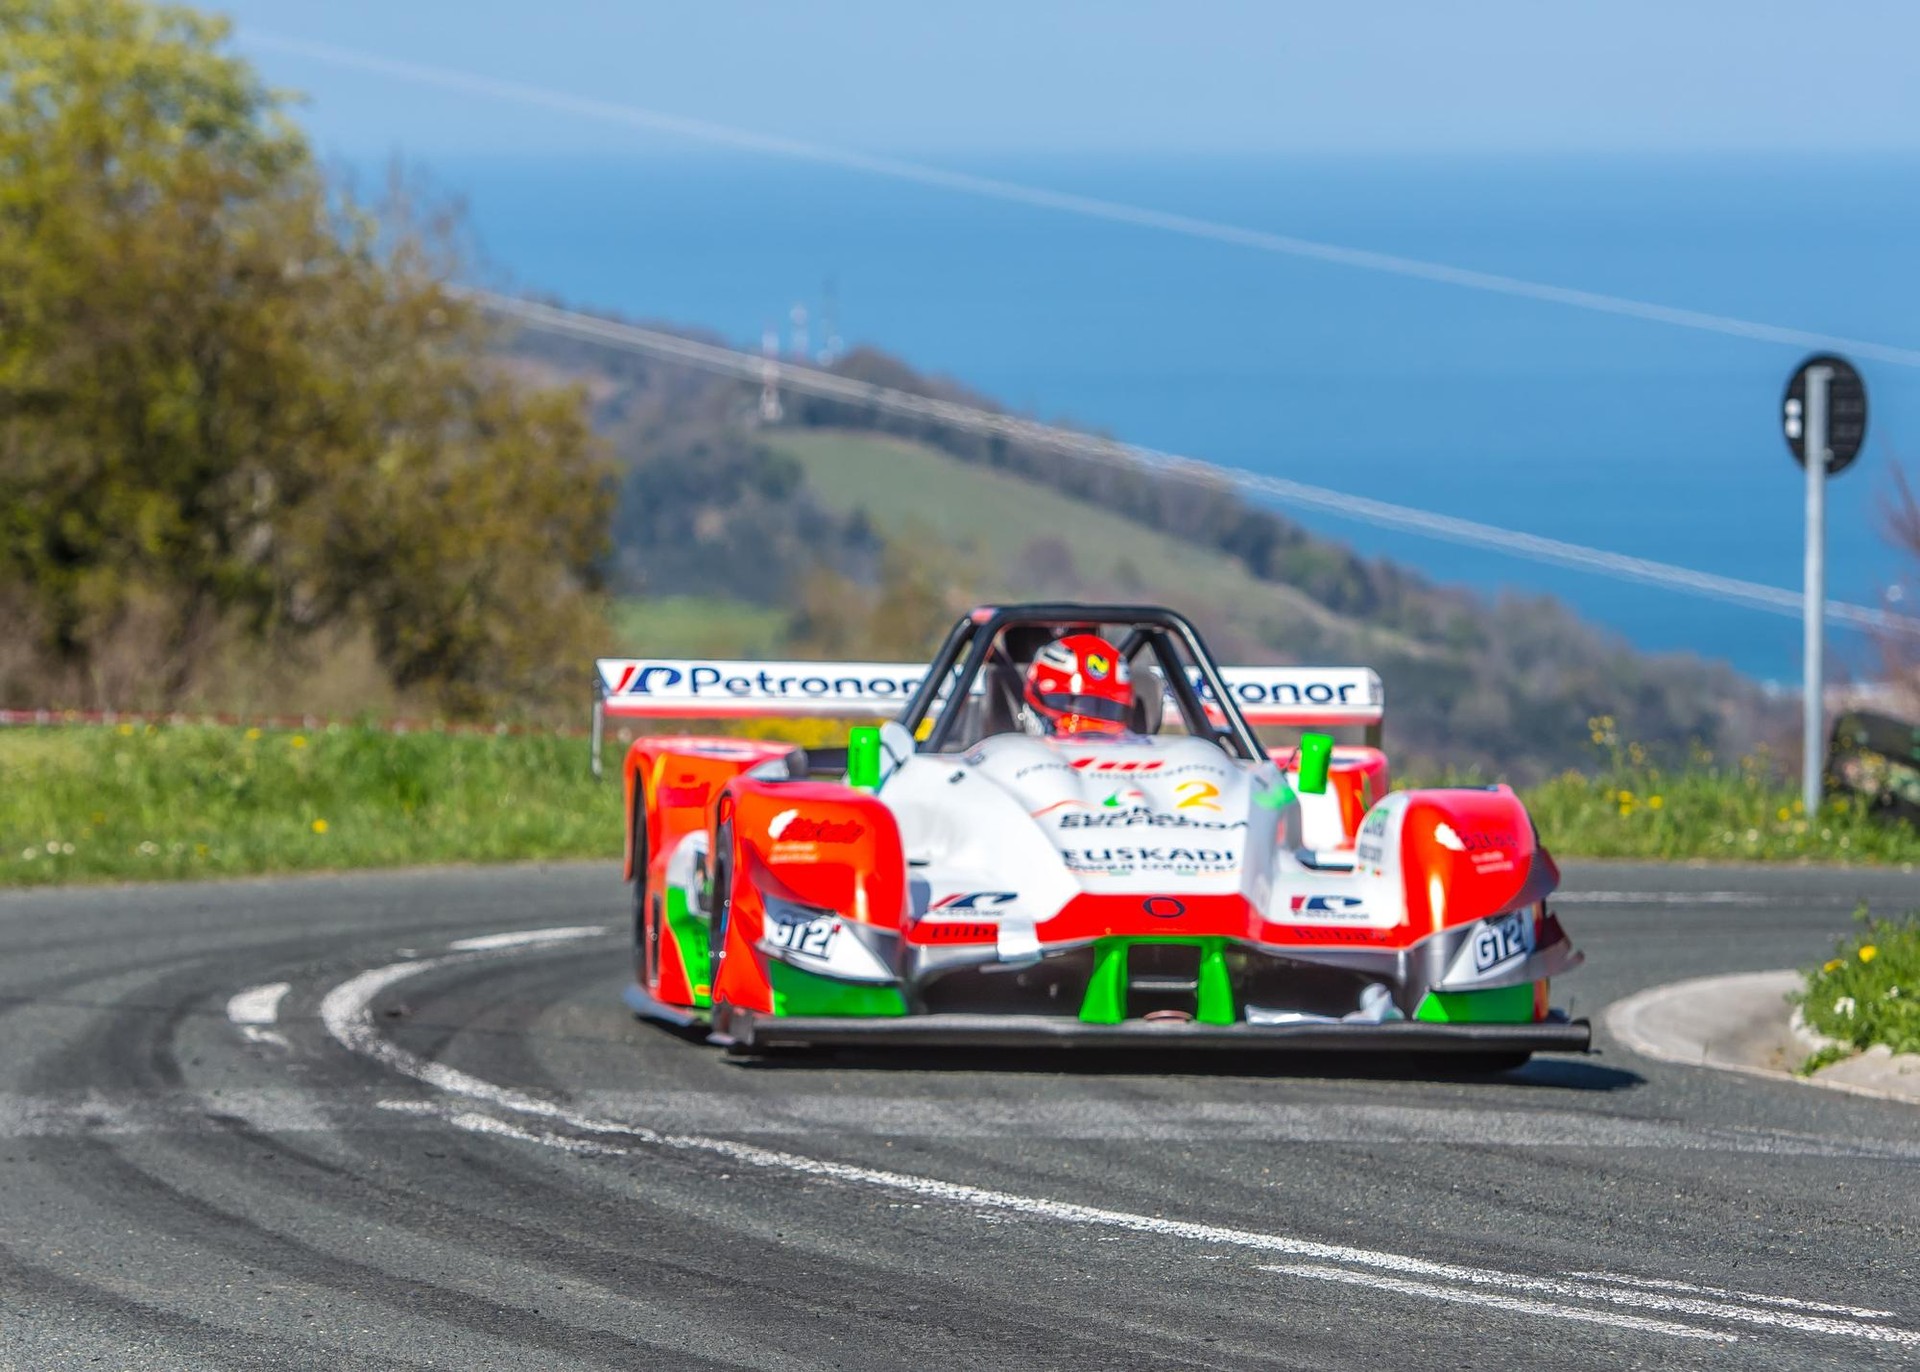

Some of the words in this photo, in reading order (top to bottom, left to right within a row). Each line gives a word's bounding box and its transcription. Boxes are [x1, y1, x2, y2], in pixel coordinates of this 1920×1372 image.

[690, 667, 924, 695] Petronor
[1175, 780, 1222, 811] 2
[1062, 848, 1235, 863] EUSKADI
